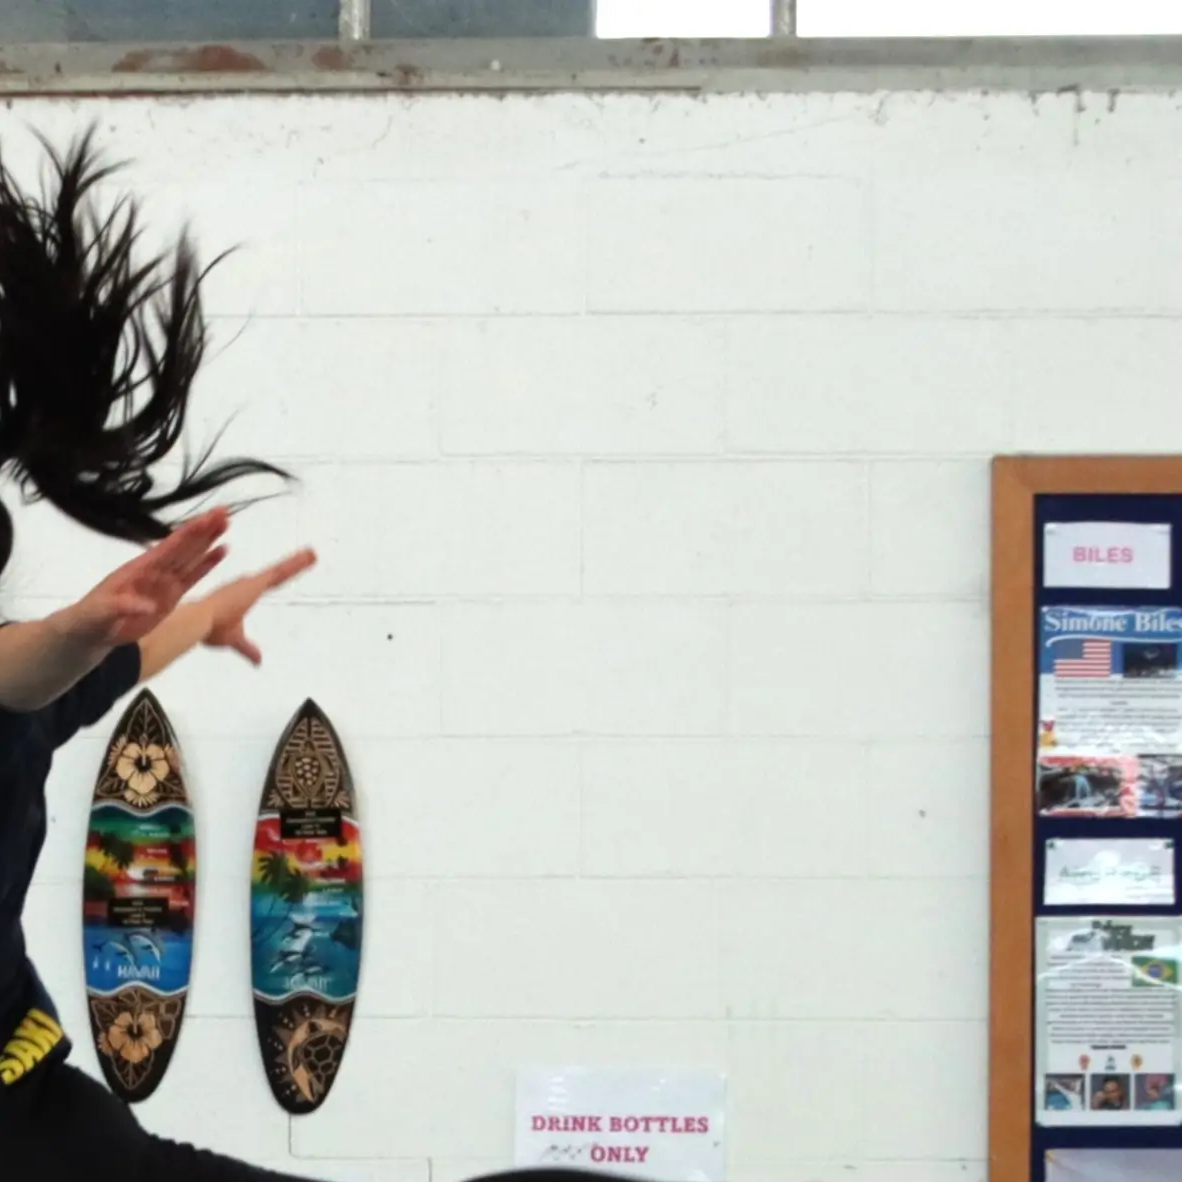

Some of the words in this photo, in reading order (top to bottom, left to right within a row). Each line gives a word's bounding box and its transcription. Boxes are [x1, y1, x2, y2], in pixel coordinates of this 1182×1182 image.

[1072, 546, 1134, 563] BILES
[1044, 612, 1128, 632] Simone
[531, 1115, 602, 1132] DRINK
[609, 1116, 709, 1133] BOTTLES
[590, 1145, 649, 1163] ONLY
